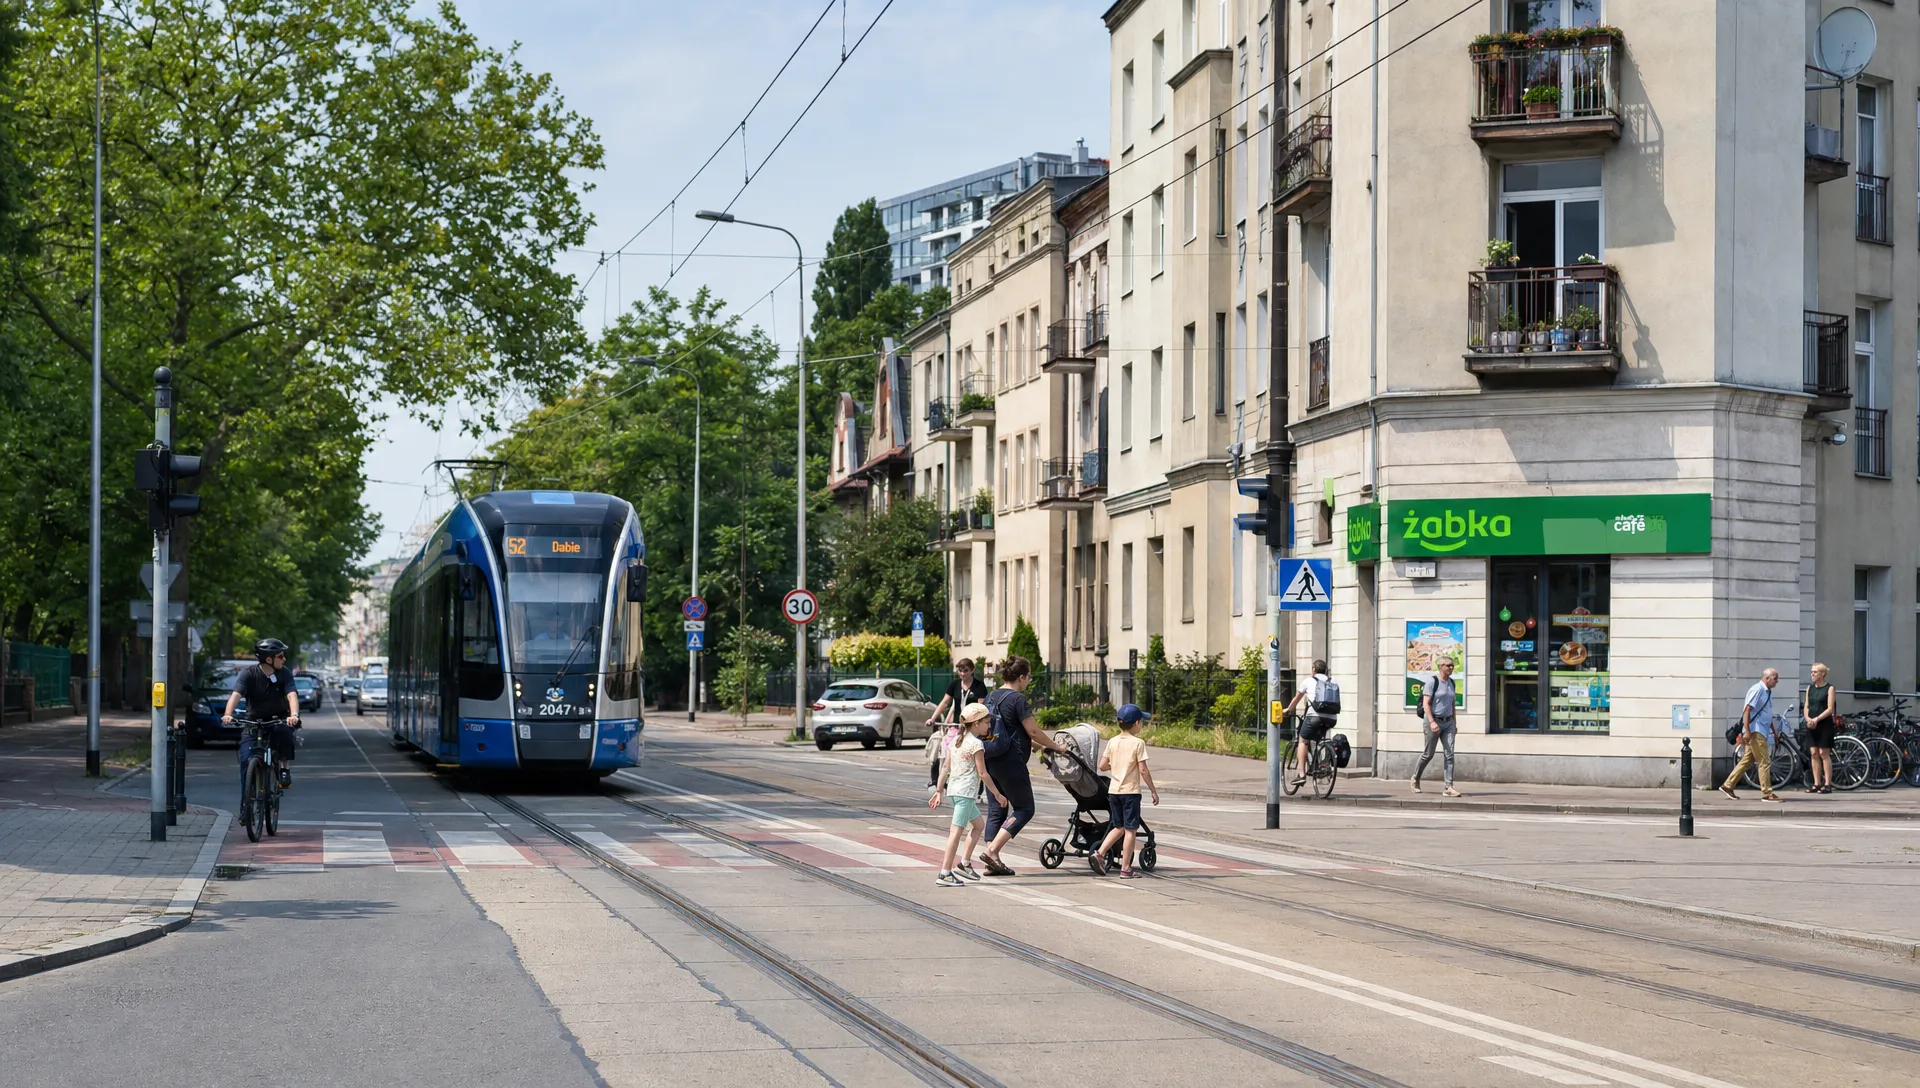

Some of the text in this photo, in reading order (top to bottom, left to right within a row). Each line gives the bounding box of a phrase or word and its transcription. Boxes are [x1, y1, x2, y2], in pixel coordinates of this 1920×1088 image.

[1403, 509, 1511, 539] żabka
[509, 537, 581, 555] 52 Dabie
[788, 598, 813, 615] 30
[539, 704, 572, 716] 2047
